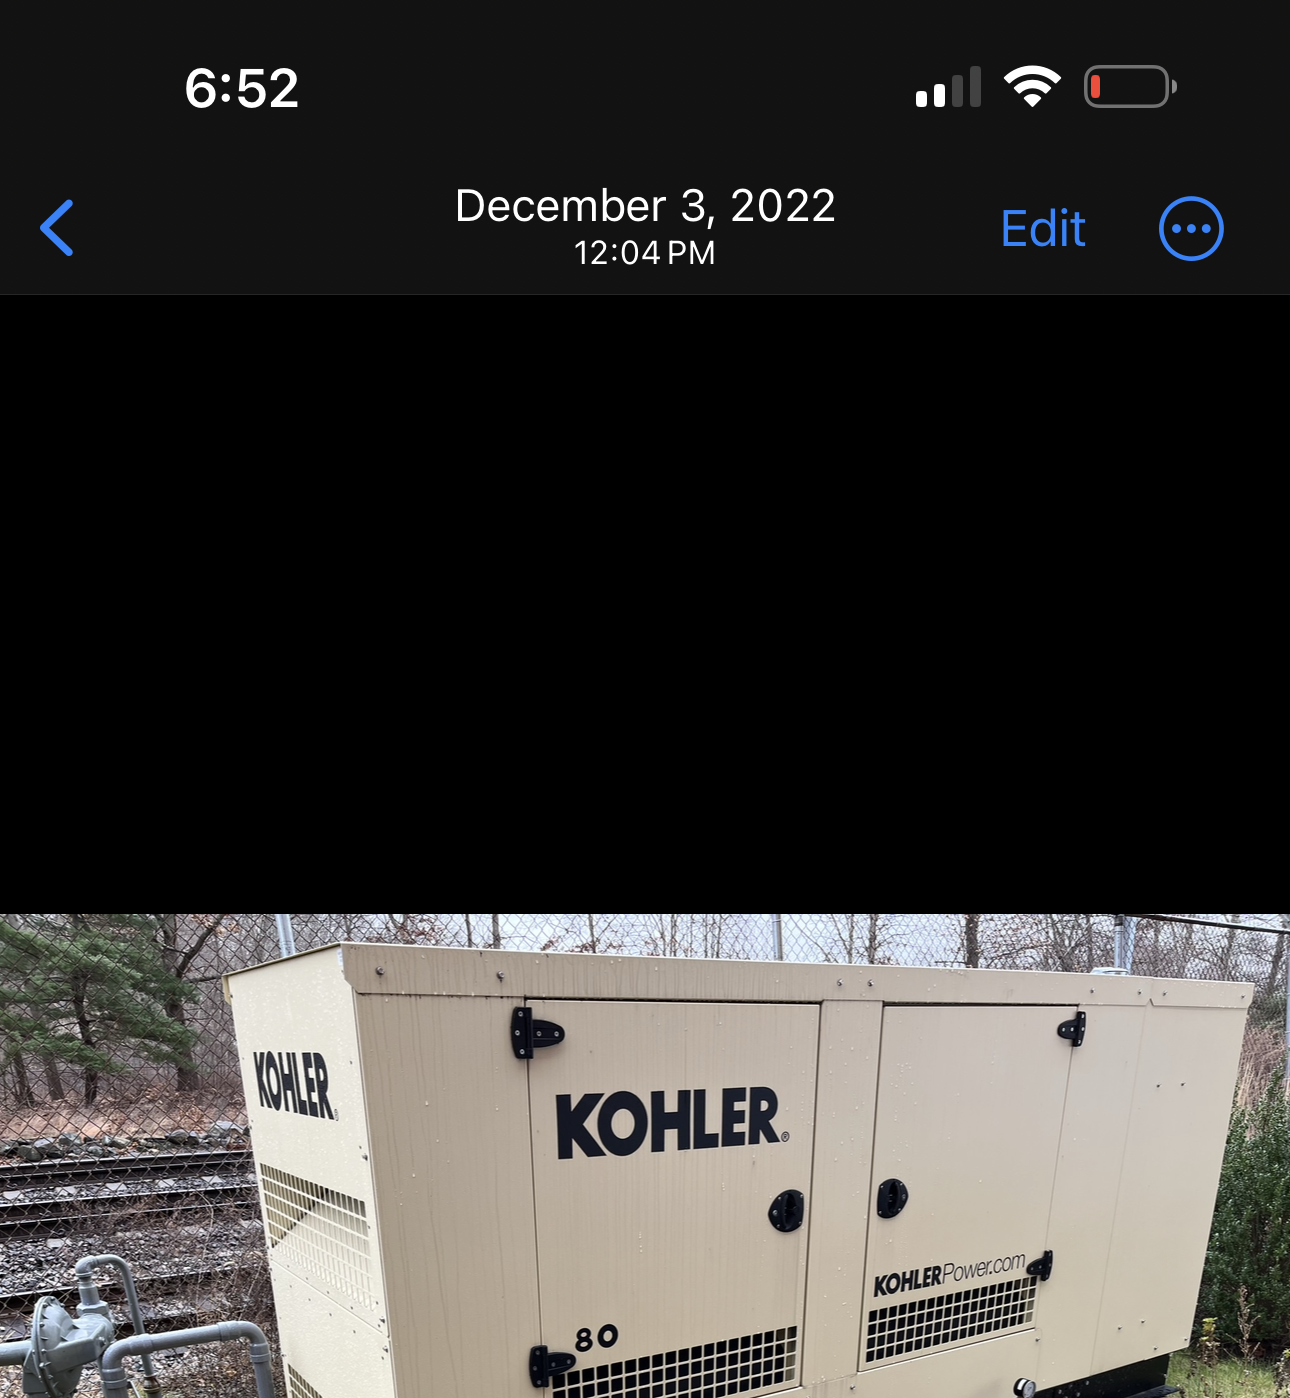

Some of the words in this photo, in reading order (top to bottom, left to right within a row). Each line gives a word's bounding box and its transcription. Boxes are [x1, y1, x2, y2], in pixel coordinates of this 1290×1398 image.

[185, 67, 299, 109] 6:52
[457, 187, 667, 223] December
[681, 188, 715, 230] 3,
[731, 187, 835, 223] 2022
[1002, 207, 1086, 248] Edit
[574, 239, 661, 266] 12:04
[668, 239, 715, 266] PM
[873, 1253, 1026, 1298] KOHLERPower.com
[574, 1323, 619, 1353] 80
